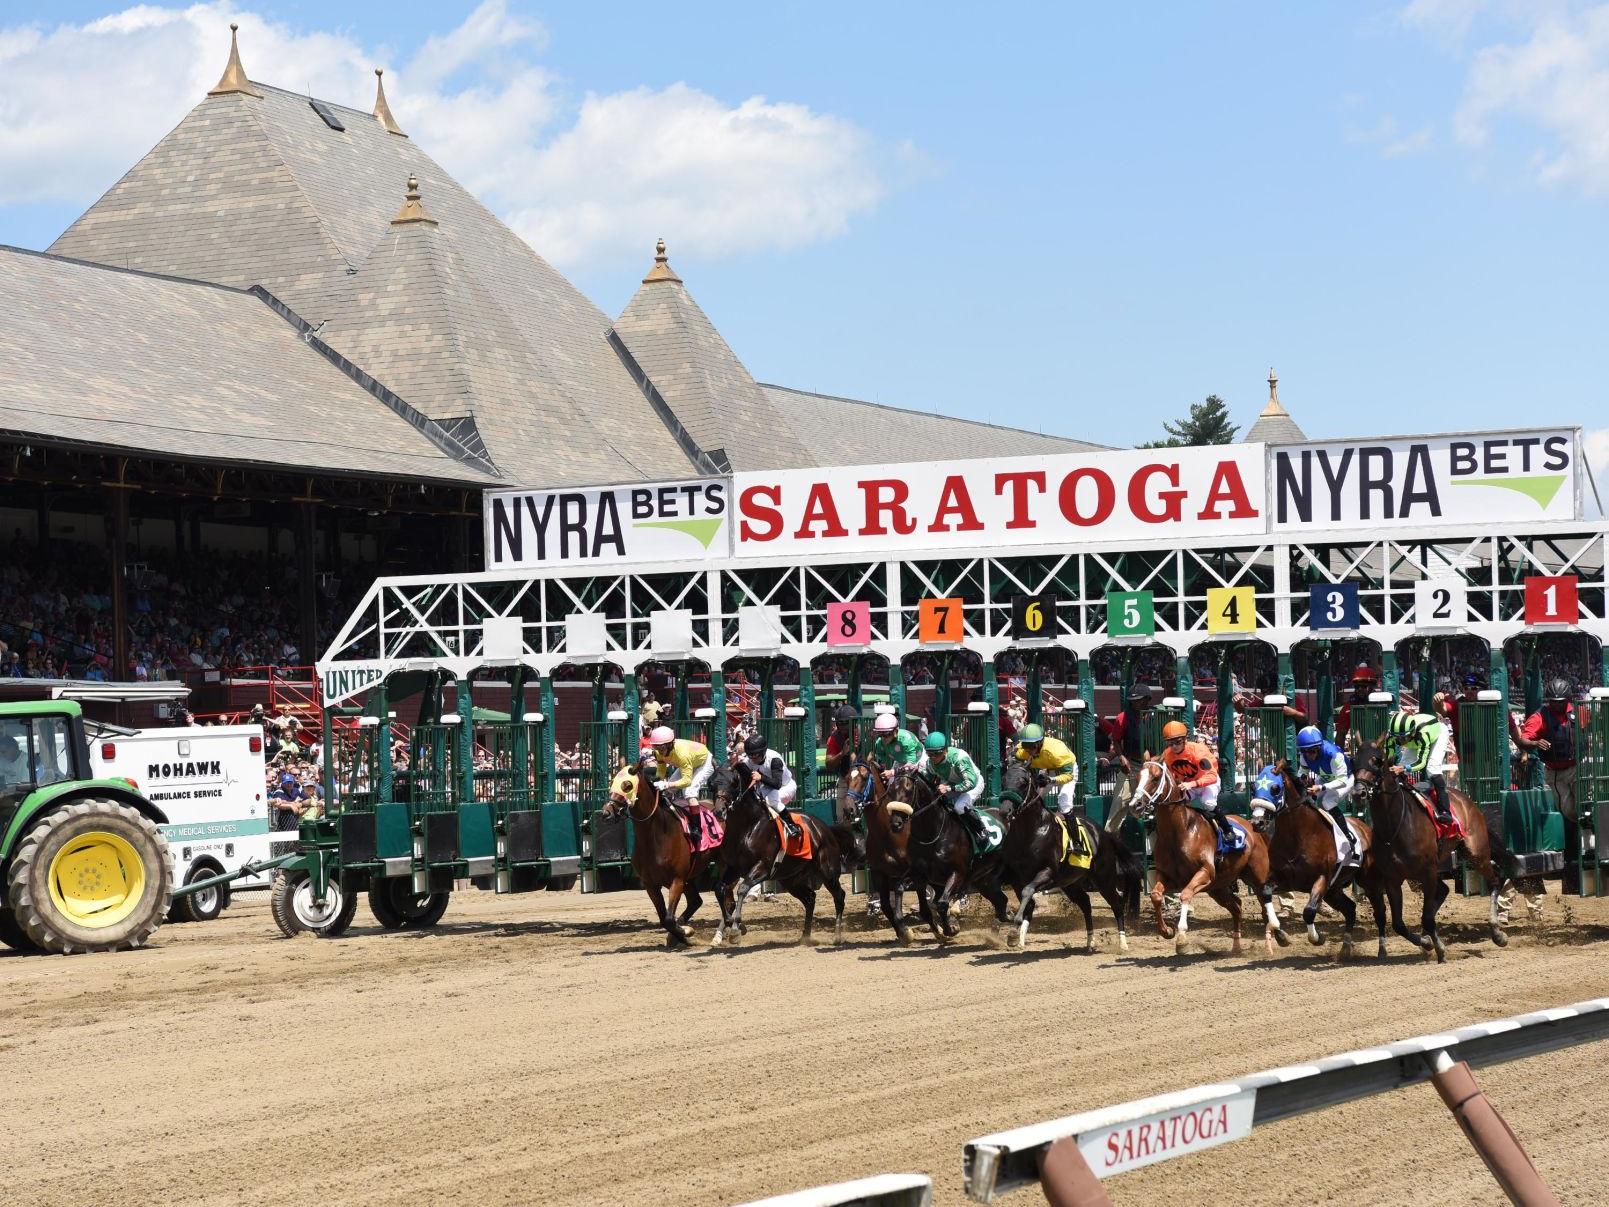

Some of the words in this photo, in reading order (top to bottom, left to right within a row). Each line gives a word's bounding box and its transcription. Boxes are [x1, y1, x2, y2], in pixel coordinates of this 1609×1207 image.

[1276, 443, 1442, 524] NYRA
[1450, 436, 1570, 476] BETS
[739, 460, 1259, 542] SARATOGA
[493, 490, 627, 563] NYRA
[631, 483, 726, 520] BETS
[1123, 598, 1141, 628] 5
[1222, 595, 1240, 625] 4
[1326, 591, 1345, 622] 3
[1432, 588, 1451, 619] 2
[1543, 584, 1558, 616] 1
[840, 609, 857, 638] 8
[933, 606, 950, 634] 7
[1025, 601, 1043, 632] 6
[325, 669, 383, 699] UNITED
[148, 760, 220, 778] MOHAWK
[149, 791, 191, 801] AMBULANCE
[193, 789, 222, 799] SERVICE
[178, 826, 205, 836] MEDICAL
[207, 824, 237, 834] SERVICES
[704, 811, 720, 840] 8
[980, 815, 1003, 846] 5
[192, 844, 213, 852] GASOLINE
